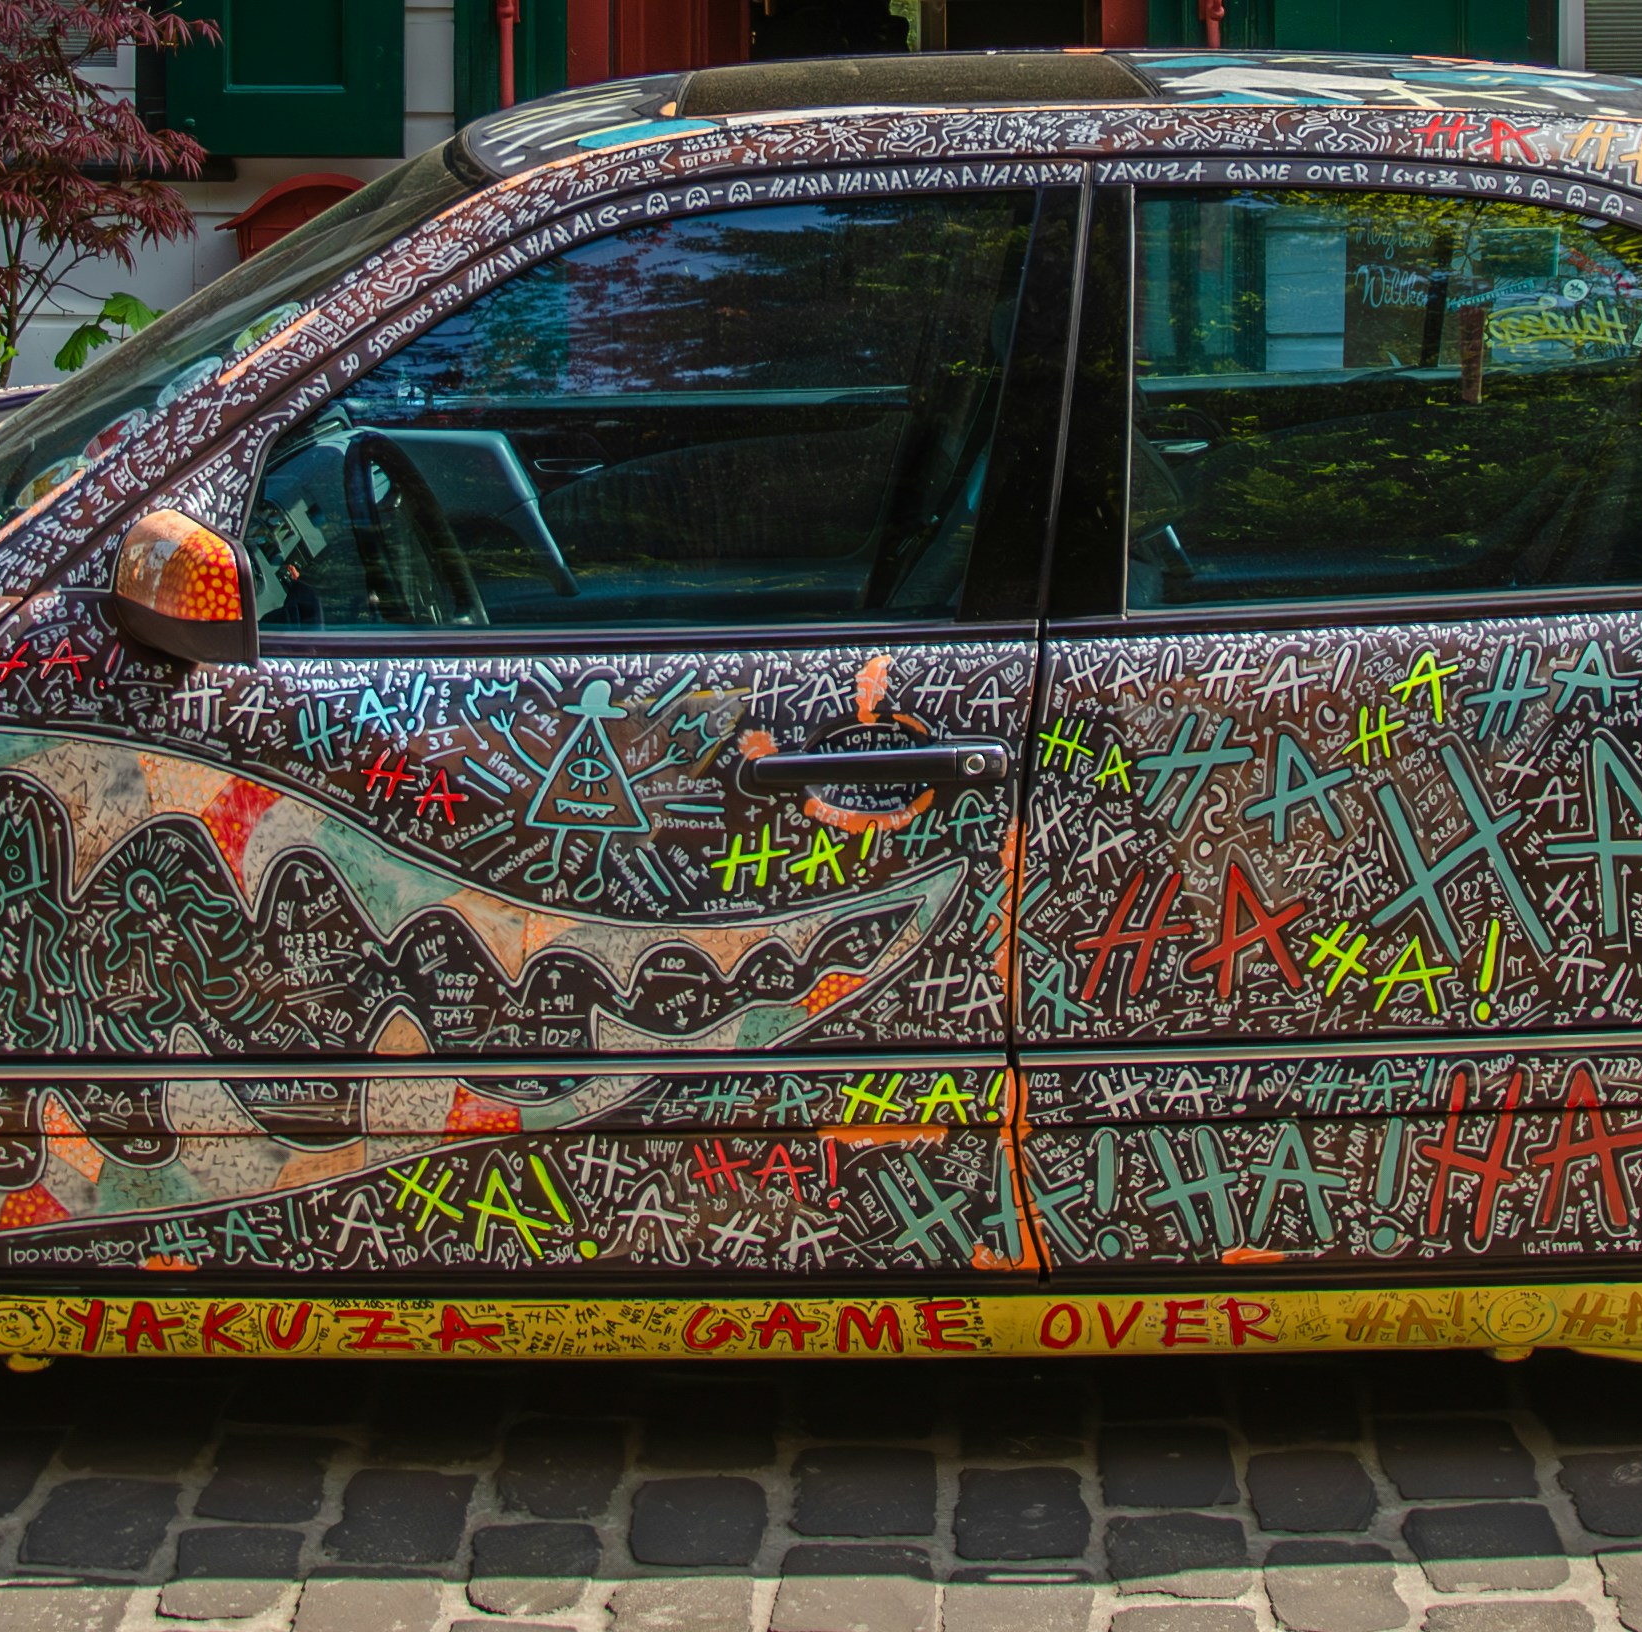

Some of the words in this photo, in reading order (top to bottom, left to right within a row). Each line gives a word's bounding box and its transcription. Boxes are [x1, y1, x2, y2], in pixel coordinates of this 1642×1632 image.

[1097, 163, 1207, 183] YAKUZA
[1226, 164, 1292, 183] GAME
[1307, 164, 1369, 184] OVER
[1412, 116, 1544, 165] HA
[837, 172, 871, 193] HA!
[293, 672, 428, 761] HA!
[360, 750, 469, 825] HA
[1039, 718, 1132, 795] HA
[1137, 714, 1354, 844] HA
[711, 820, 877, 892] HA!
[1075, 862, 1307, 1001] HA
[1309, 919, 1503, 1022] HA!
[244, 1083, 339, 1101] YAMATO
[695, 1076, 824, 1126] HA
[841, 1073, 1005, 1125] HA!
[387, 1154, 599, 1259] HA!
[693, 1137, 842, 1210] HA!
[1146, 1117, 1408, 1254] HA!
[64, 1298, 506, 1354] YAKUZA
[684, 1299, 981, 1354] GAME
[1039, 1299, 1283, 1349] OVER
